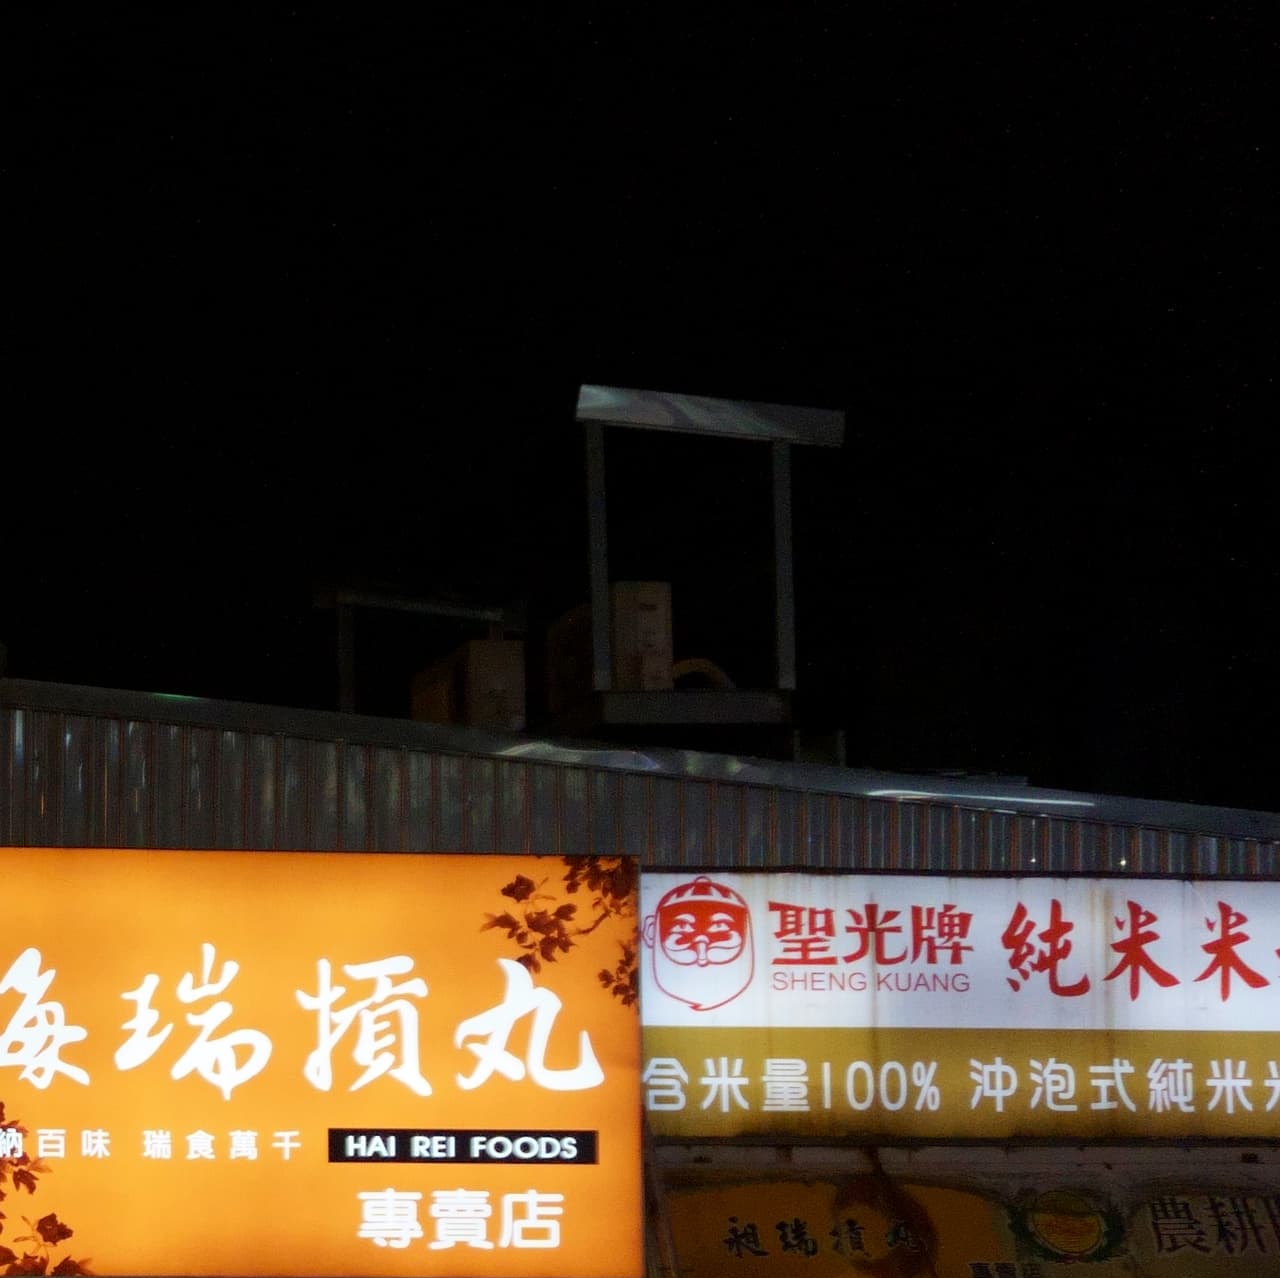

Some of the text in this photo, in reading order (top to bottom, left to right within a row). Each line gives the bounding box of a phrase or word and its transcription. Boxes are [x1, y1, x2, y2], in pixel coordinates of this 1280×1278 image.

[768, 902, 975, 966] 聖光牌
[1002, 898, 1280, 1002] 純米米
[772, 972, 971, 993] SHENG KUANG
[643, 1057, 941, 1113] 含米量100%
[143, 1129, 302, 1161] 瑞食萬千
[345, 1135, 578, 1159] HAI REI FOODS
[357, 1188, 565, 1251] 專賣店
[1151, 1196, 1280, 1254] 農耕
